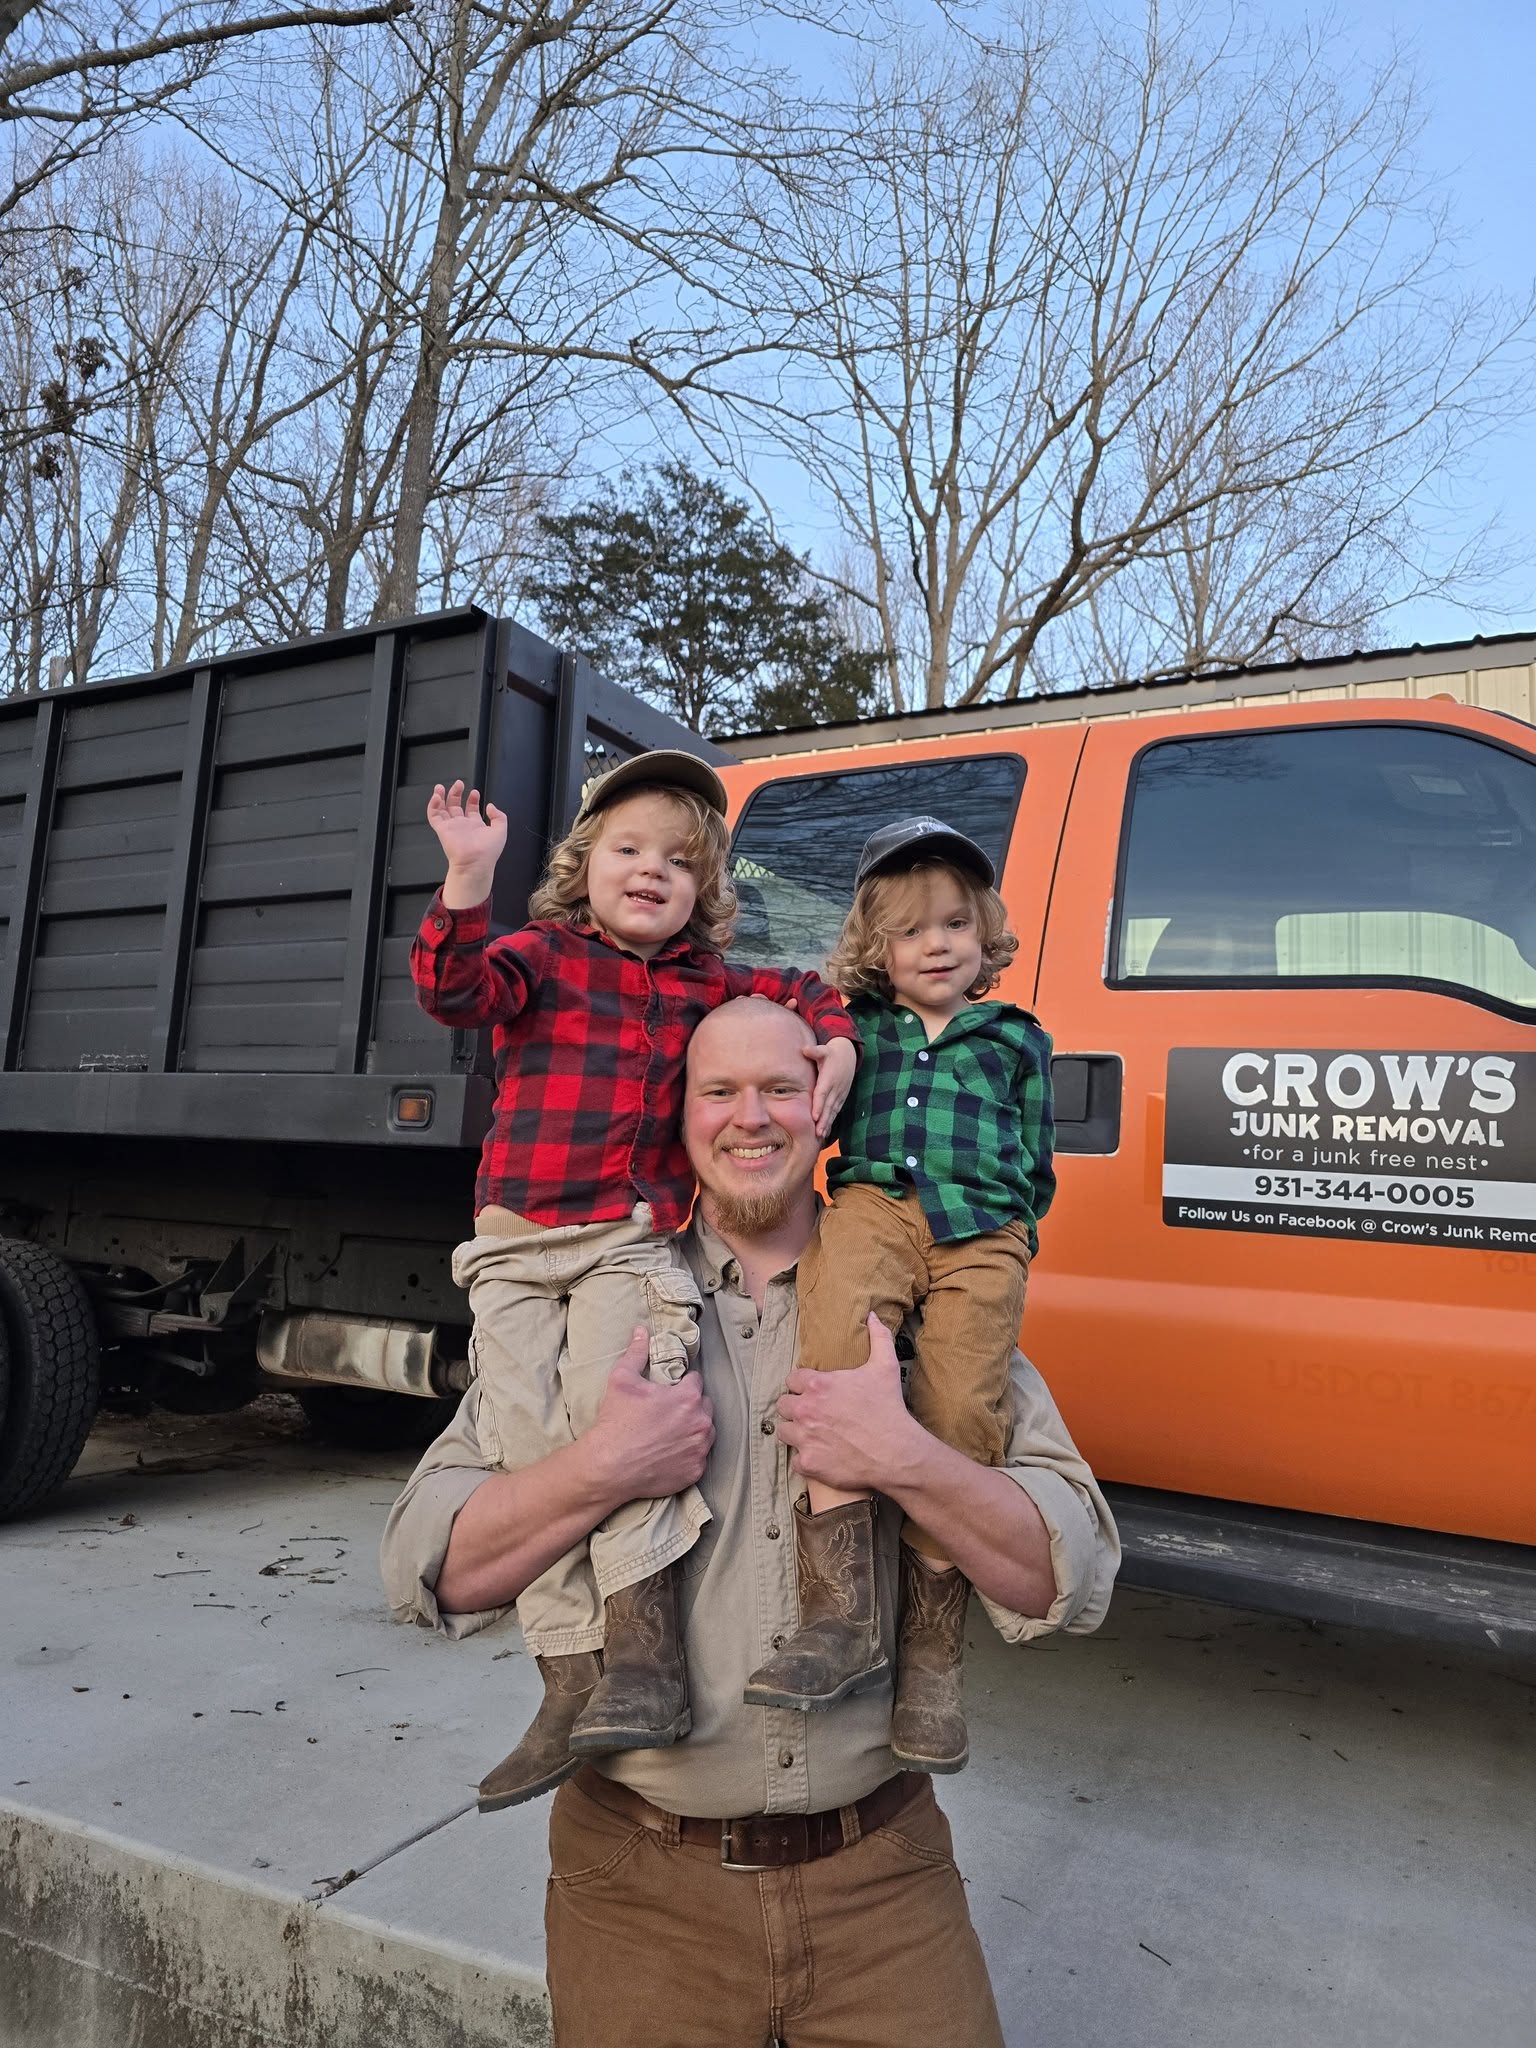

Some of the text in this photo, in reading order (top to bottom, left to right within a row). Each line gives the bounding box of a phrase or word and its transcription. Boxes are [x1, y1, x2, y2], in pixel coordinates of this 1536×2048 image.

[1221, 1052, 1517, 1114] CROW'S
[1229, 1110, 1505, 1147] JUNK REMOVAL
[1292, 1149, 1304, 1162] a
[1311, 1146, 1360, 1166] junk
[1370, 1150, 1416, 1168] free
[1254, 1174, 1475, 1209] 931-344-0005
[1178, 1206, 1227, 1222] Follow
[1231, 1210, 1251, 1223] Us
[1254, 1213, 1274, 1225] on
[1278, 1213, 1357, 1231] Facebook
[1361, 1218, 1377, 1234] @
[1382, 1219, 1438, 1236] Crow's
[1443, 1224, 1484, 1240] Junk
